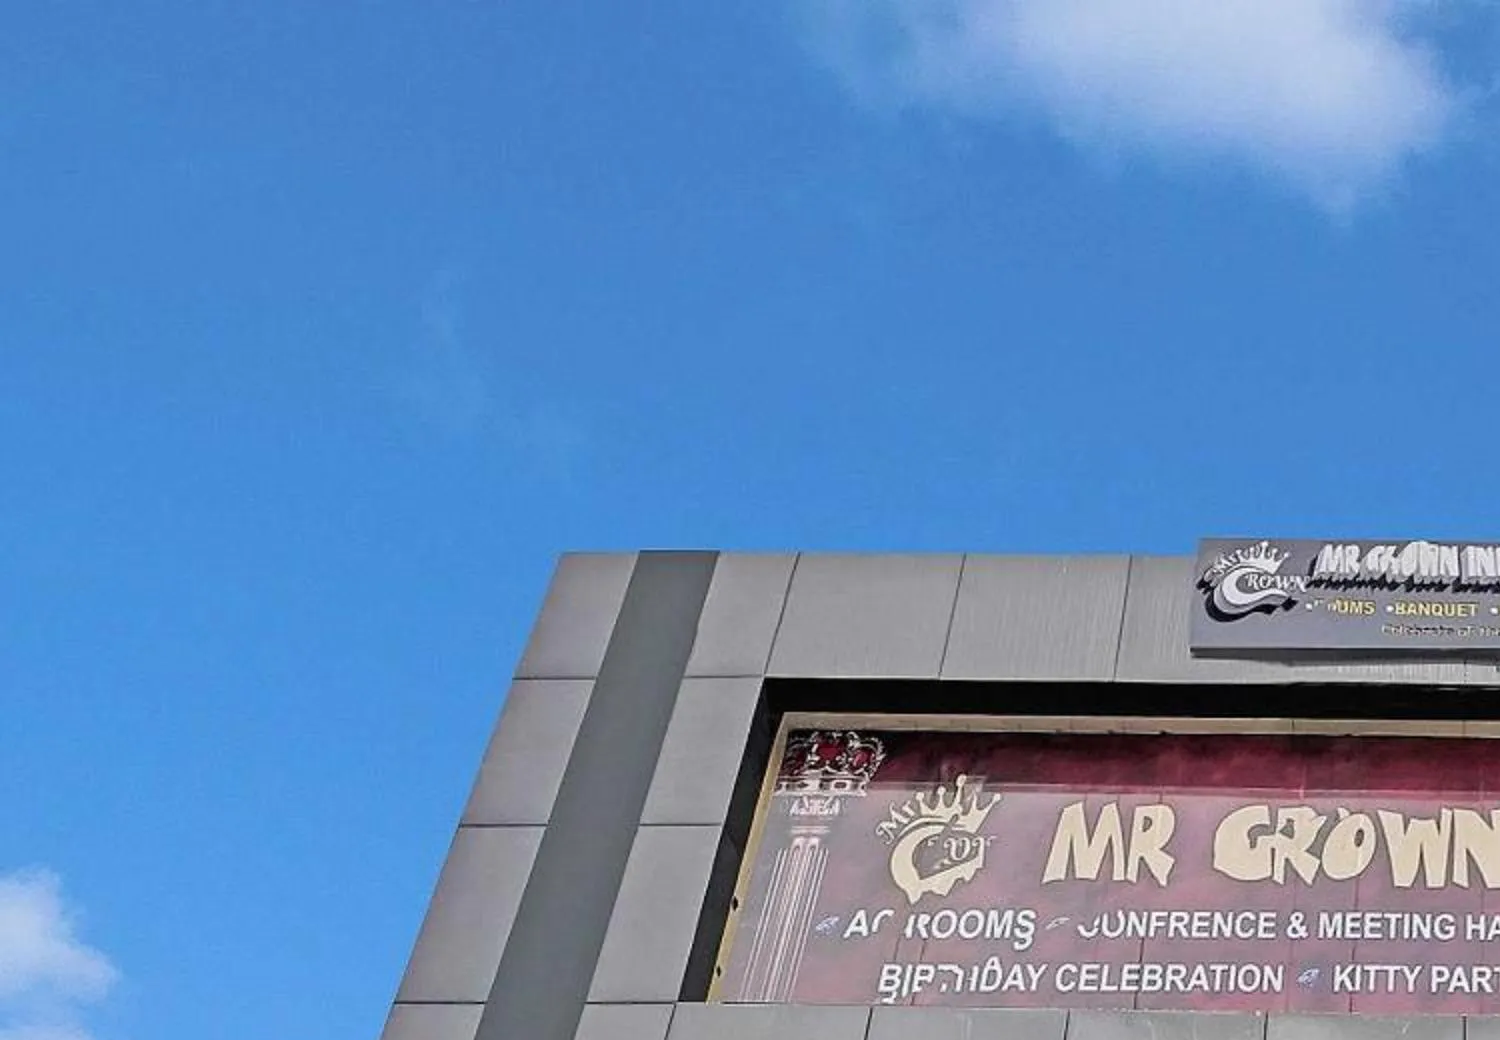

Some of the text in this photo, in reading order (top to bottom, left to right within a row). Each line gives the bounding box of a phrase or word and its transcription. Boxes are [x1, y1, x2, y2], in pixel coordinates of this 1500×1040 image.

[1313, 544, 1362, 576] MR
[1395, 602, 1480, 618] BANQUET
[1042, 802, 1175, 887] MR
[904, 909, 1037, 951] ROOMS
[1286, 911, 1308, 938] &
[1317, 913, 1456, 941] MEETING
[1055, 964, 1284, 993] CELEBRATION
[1333, 965, 1423, 992] KITTY
